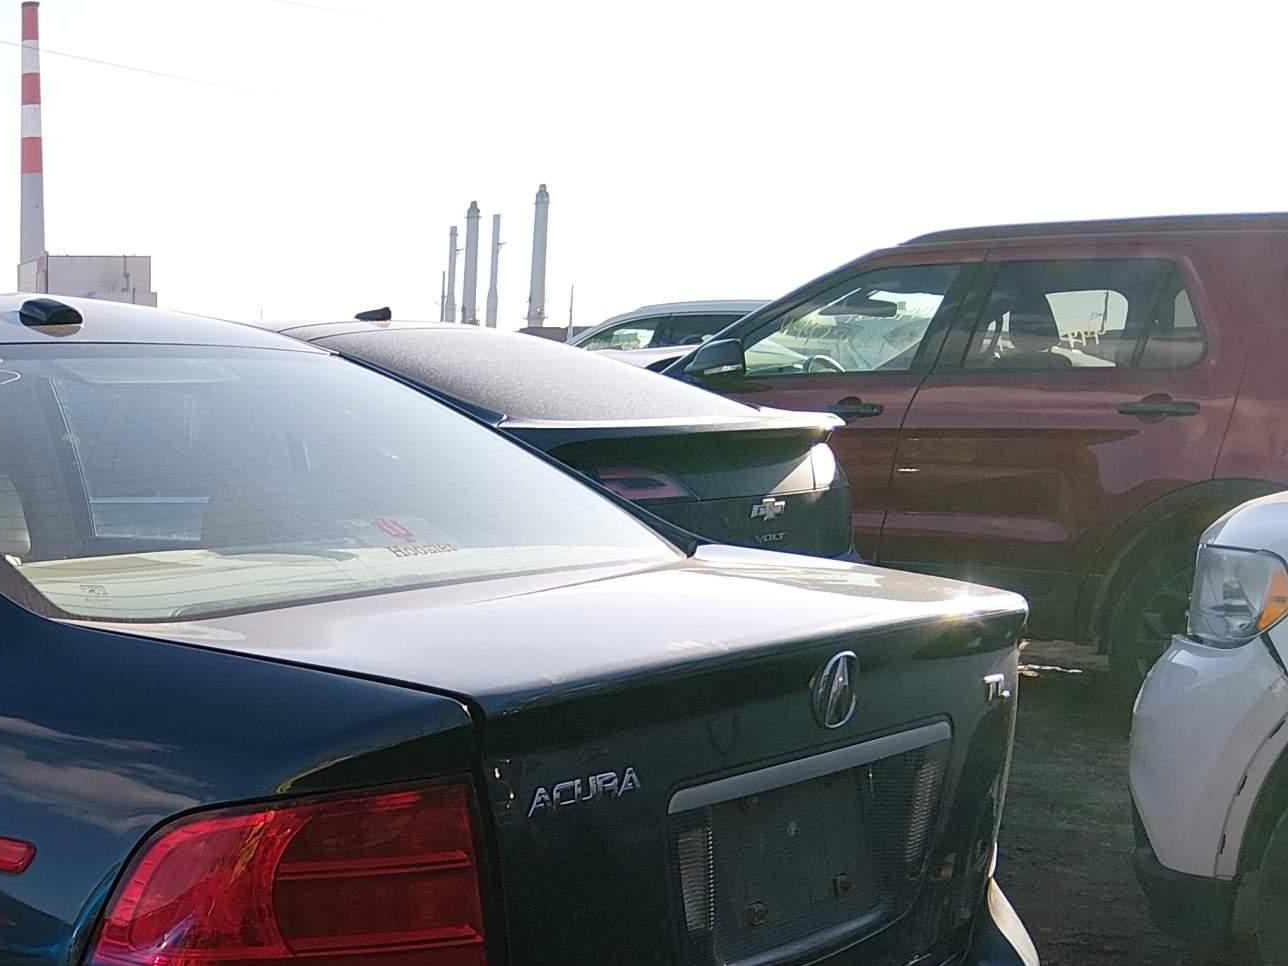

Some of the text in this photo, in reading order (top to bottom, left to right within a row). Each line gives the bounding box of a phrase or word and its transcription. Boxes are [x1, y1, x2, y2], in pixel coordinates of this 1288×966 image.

[754, 531, 787, 544] VOLT
[982, 672, 1012, 702] TL
[526, 766, 642, 818] ACURA
